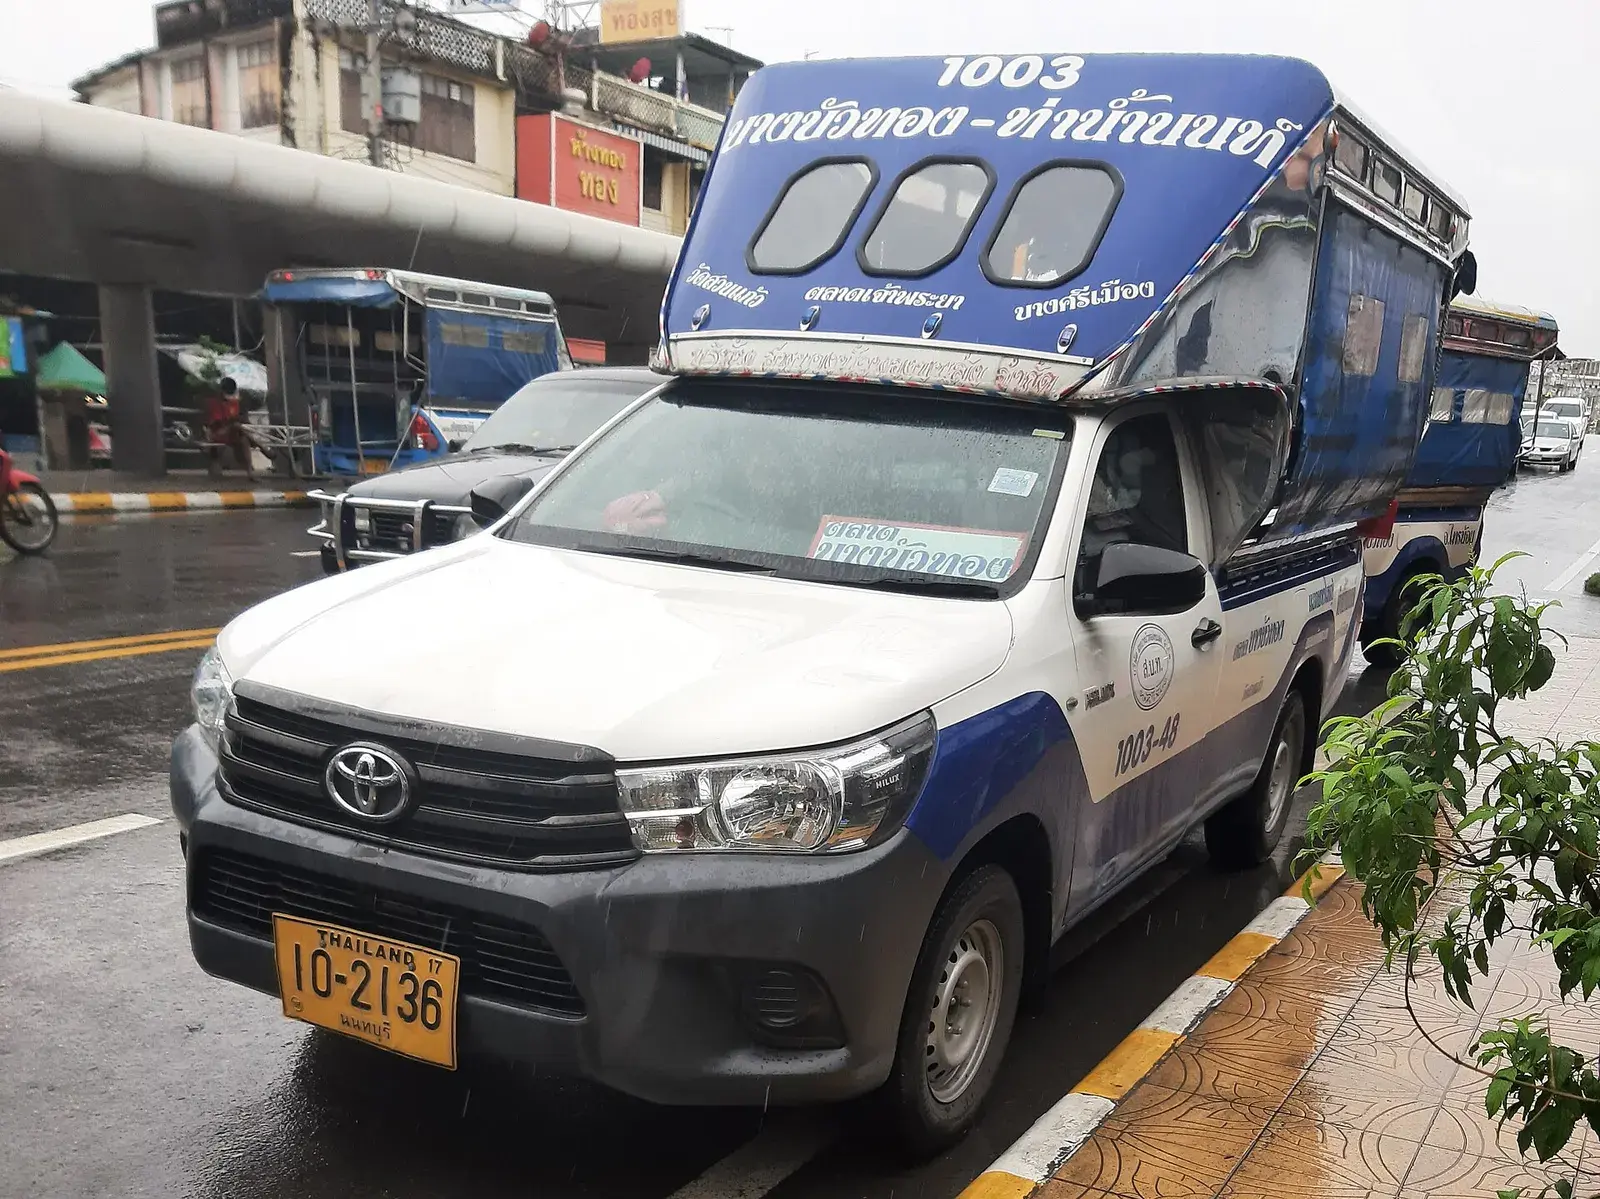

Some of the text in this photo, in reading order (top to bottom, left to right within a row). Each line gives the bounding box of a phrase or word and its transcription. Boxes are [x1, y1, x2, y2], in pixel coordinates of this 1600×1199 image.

[937, 55, 1086, 90] 1003
[685, 262, 769, 308] วัดสวนแก้ว
[804, 283, 965, 311] ตลาดเจ้าพระยา
[1014, 278, 1156, 321] บางศรีเมือง
[823, 521, 900, 542] ตลาด
[814, 538, 1015, 579] บางบัวทอง
[1115, 712, 1180, 777] 1003-48
[875, 773, 900, 789] HILUX
[317, 928, 443, 975] THAILAND 17
[294, 943, 443, 1031] 10-2136
[340, 1013, 392, 1042] นนทบุรี
